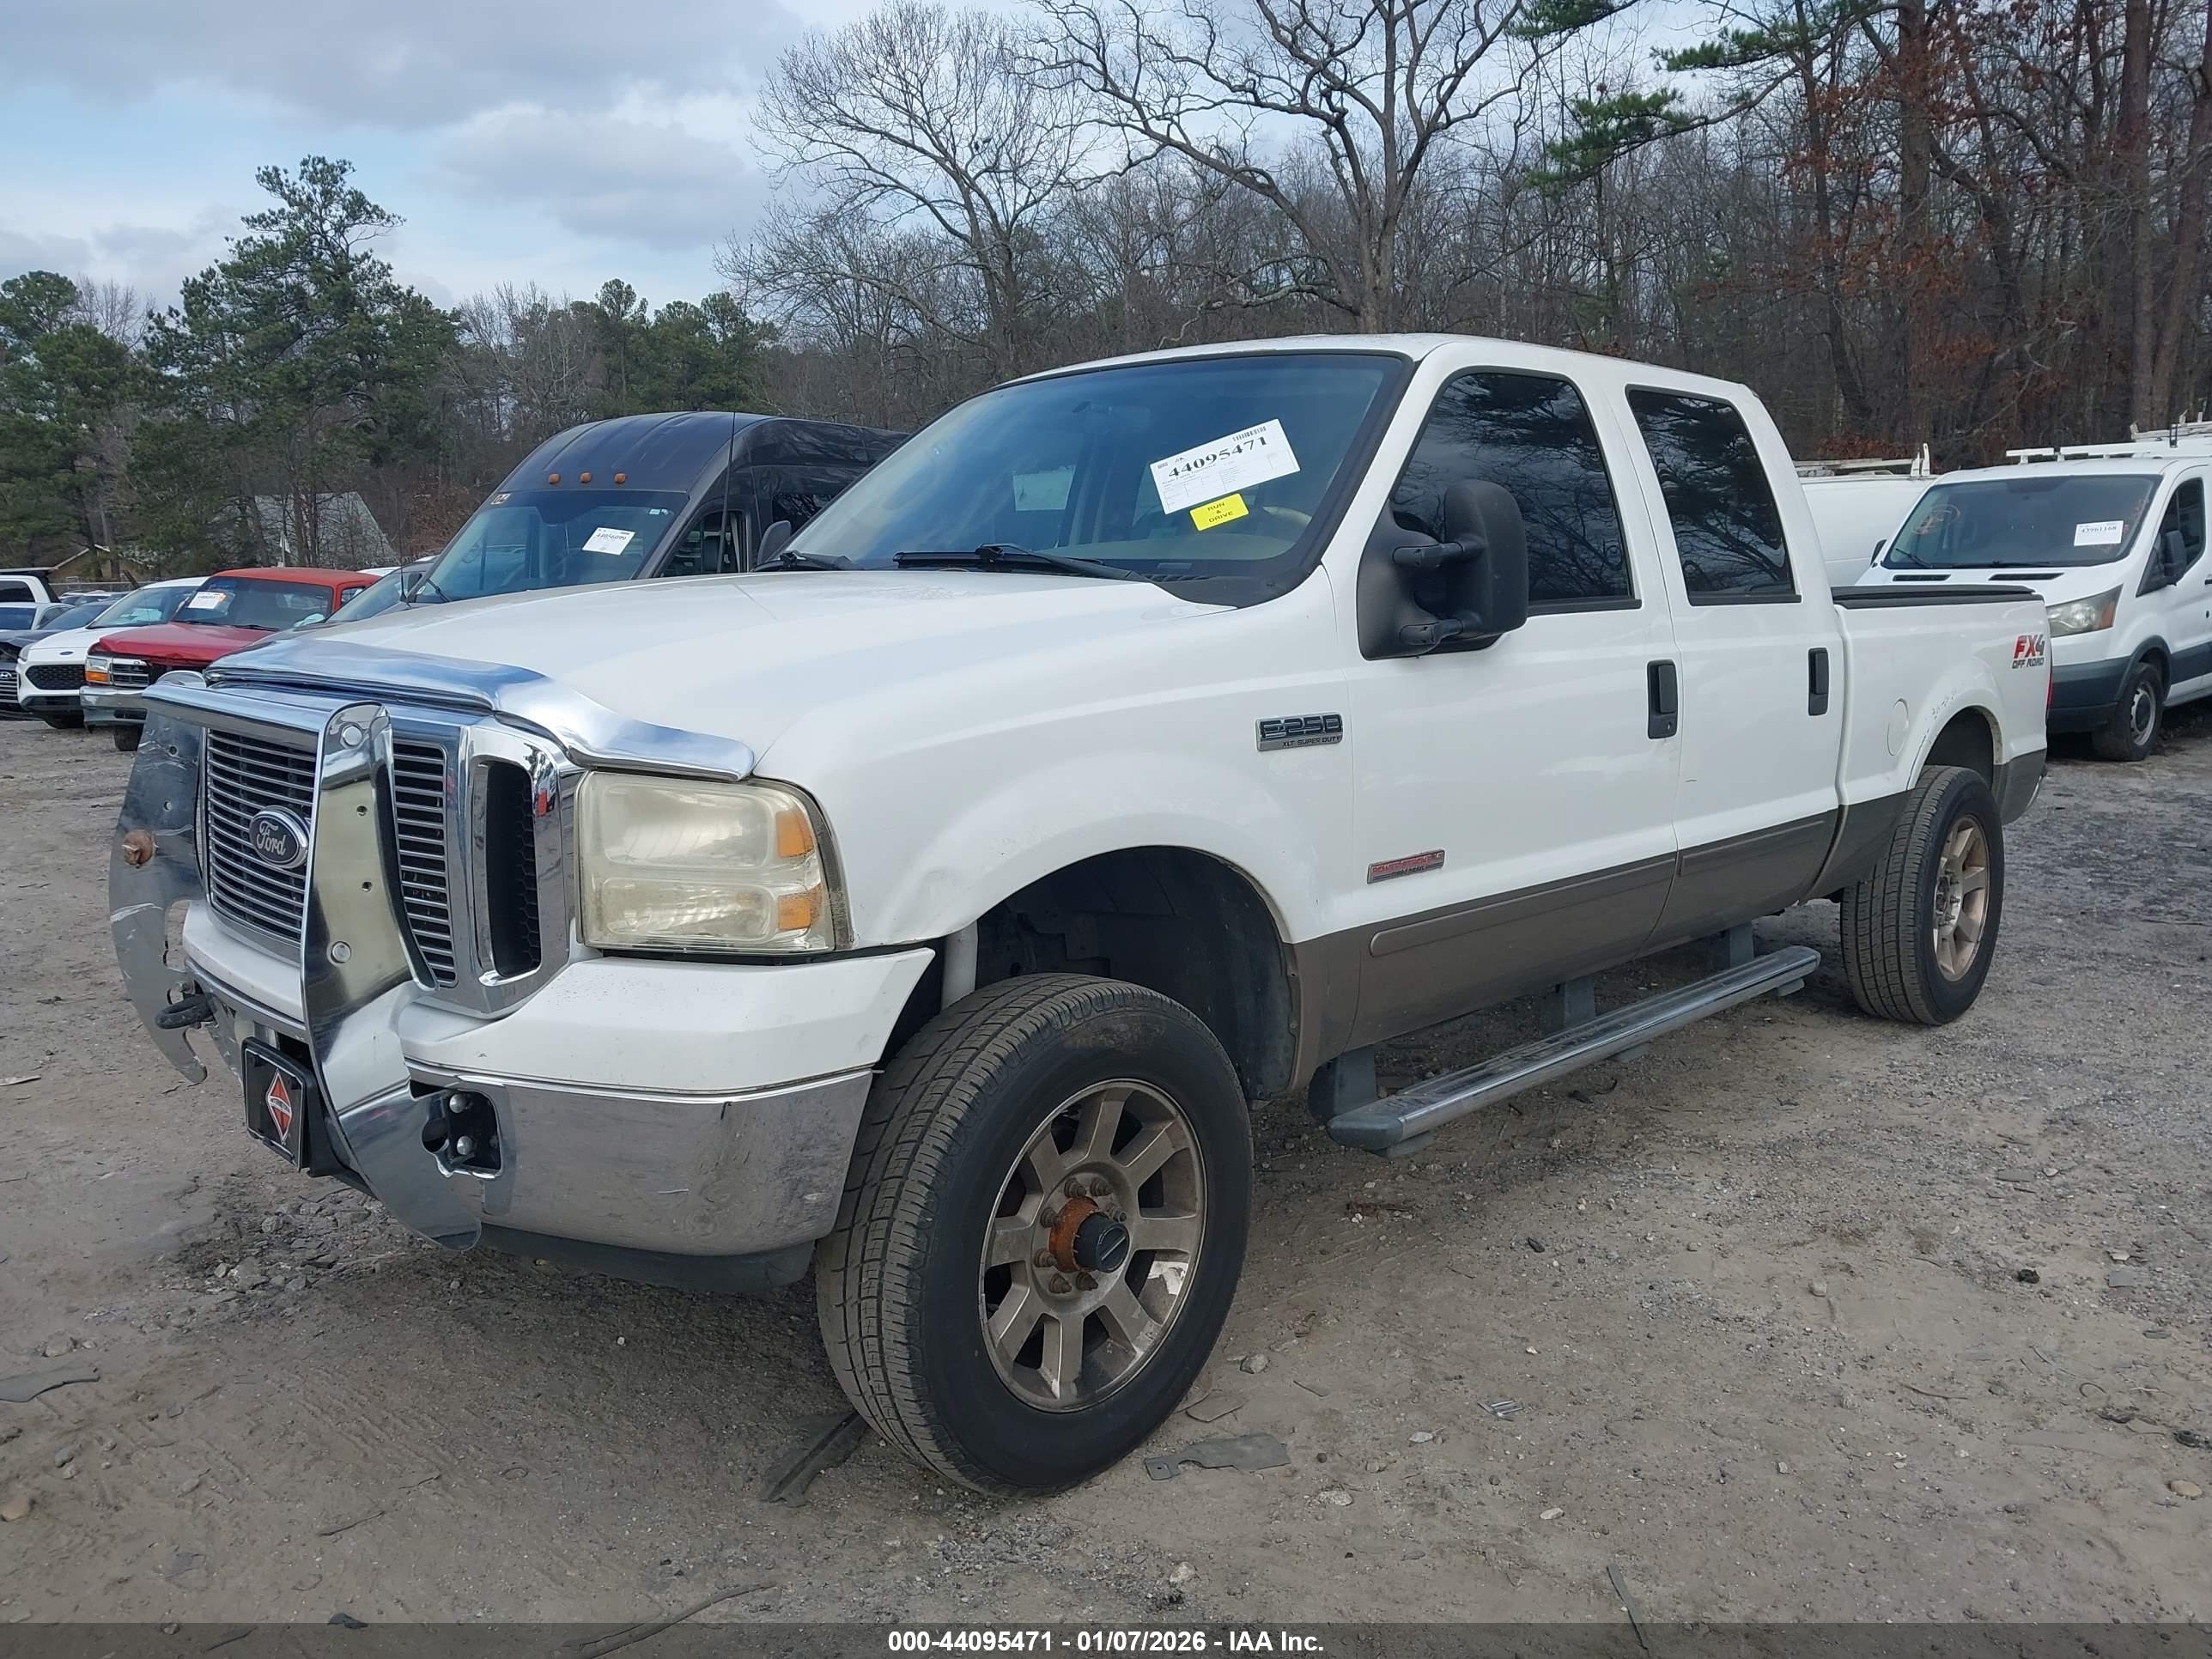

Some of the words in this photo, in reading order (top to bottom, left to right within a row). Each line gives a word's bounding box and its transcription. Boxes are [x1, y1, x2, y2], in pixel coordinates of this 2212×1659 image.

[1169, 436, 1268, 478] 44095471
[1207, 501, 1225, 512] RUN
[1208, 511, 1234, 523] DRIVE
[2014, 634, 2045, 659] FX4
[2012, 659, 2026, 669] OFF
[2027, 657, 2045, 667] ROAD
[1297, 738, 1321, 746] SUPER
[257, 820, 287, 856] Ford
